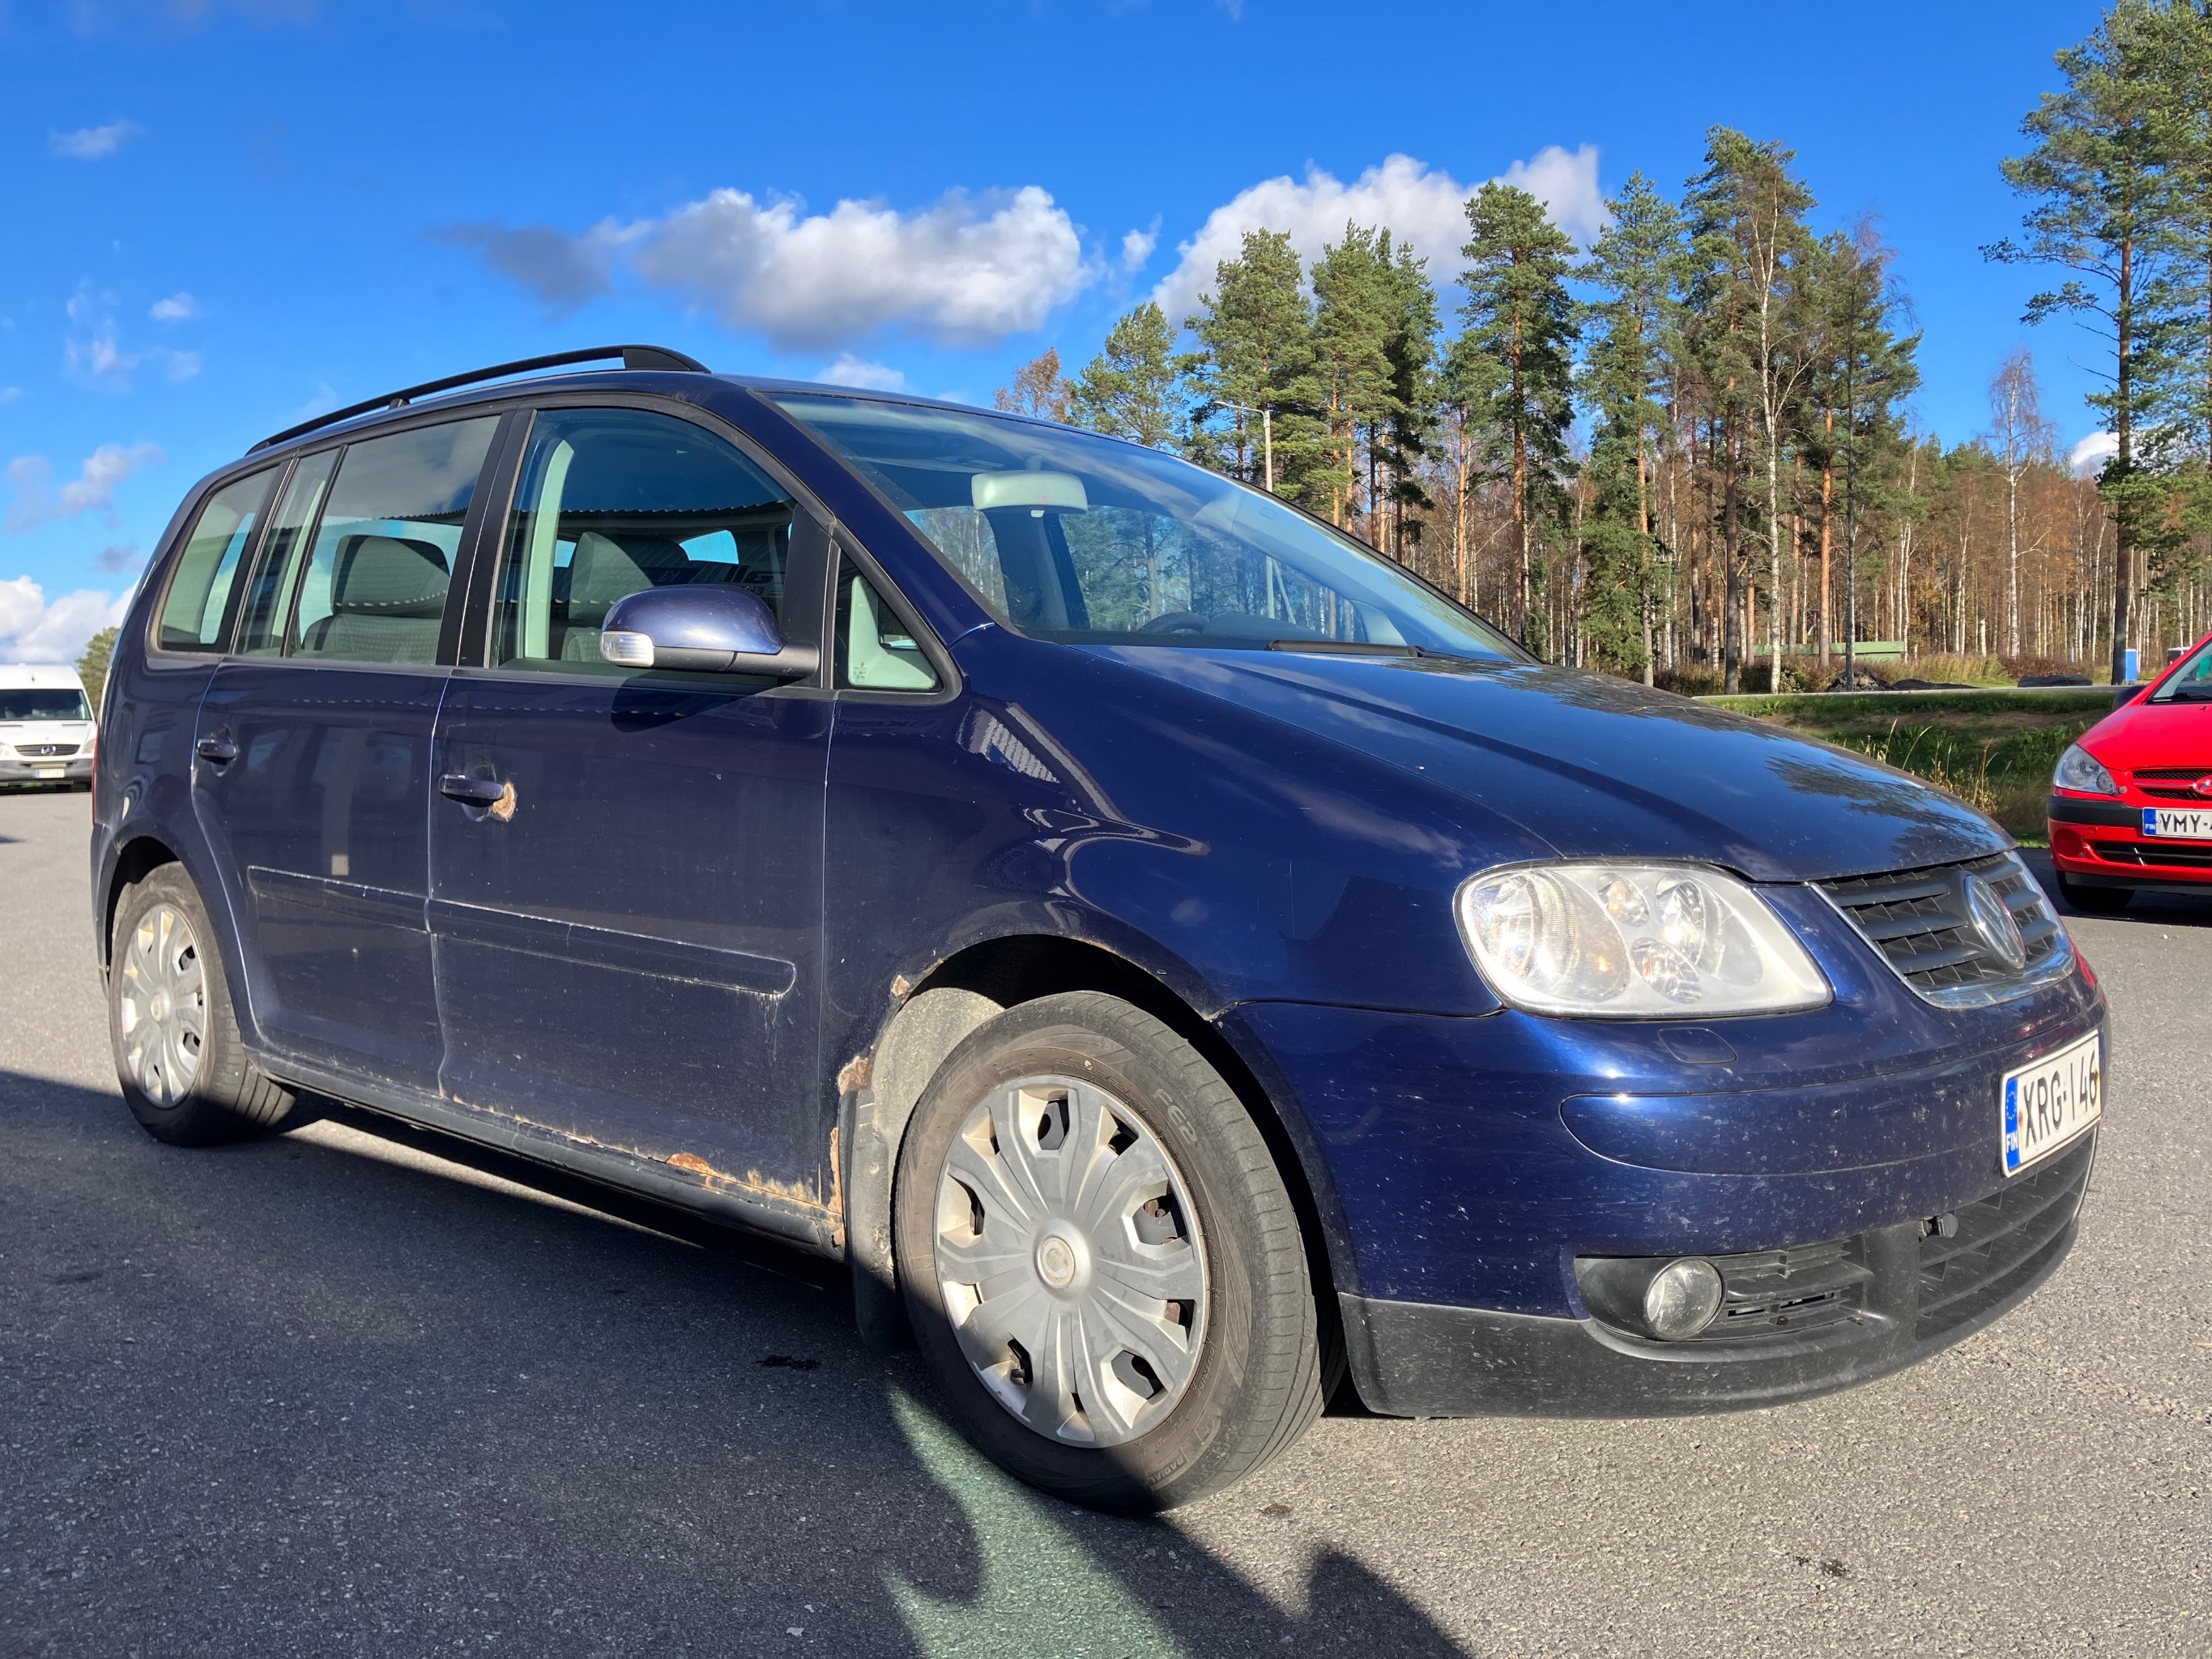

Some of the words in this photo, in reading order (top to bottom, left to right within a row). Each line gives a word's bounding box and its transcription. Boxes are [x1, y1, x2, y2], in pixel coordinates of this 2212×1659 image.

[2023, 1049, 2099, 1149] XRG-146
[2005, 1132, 2018, 1154] FIN
[1196, 1346, 1215, 1398] OUTSIDE
[1148, 1456, 1185, 1484] RADIAL
